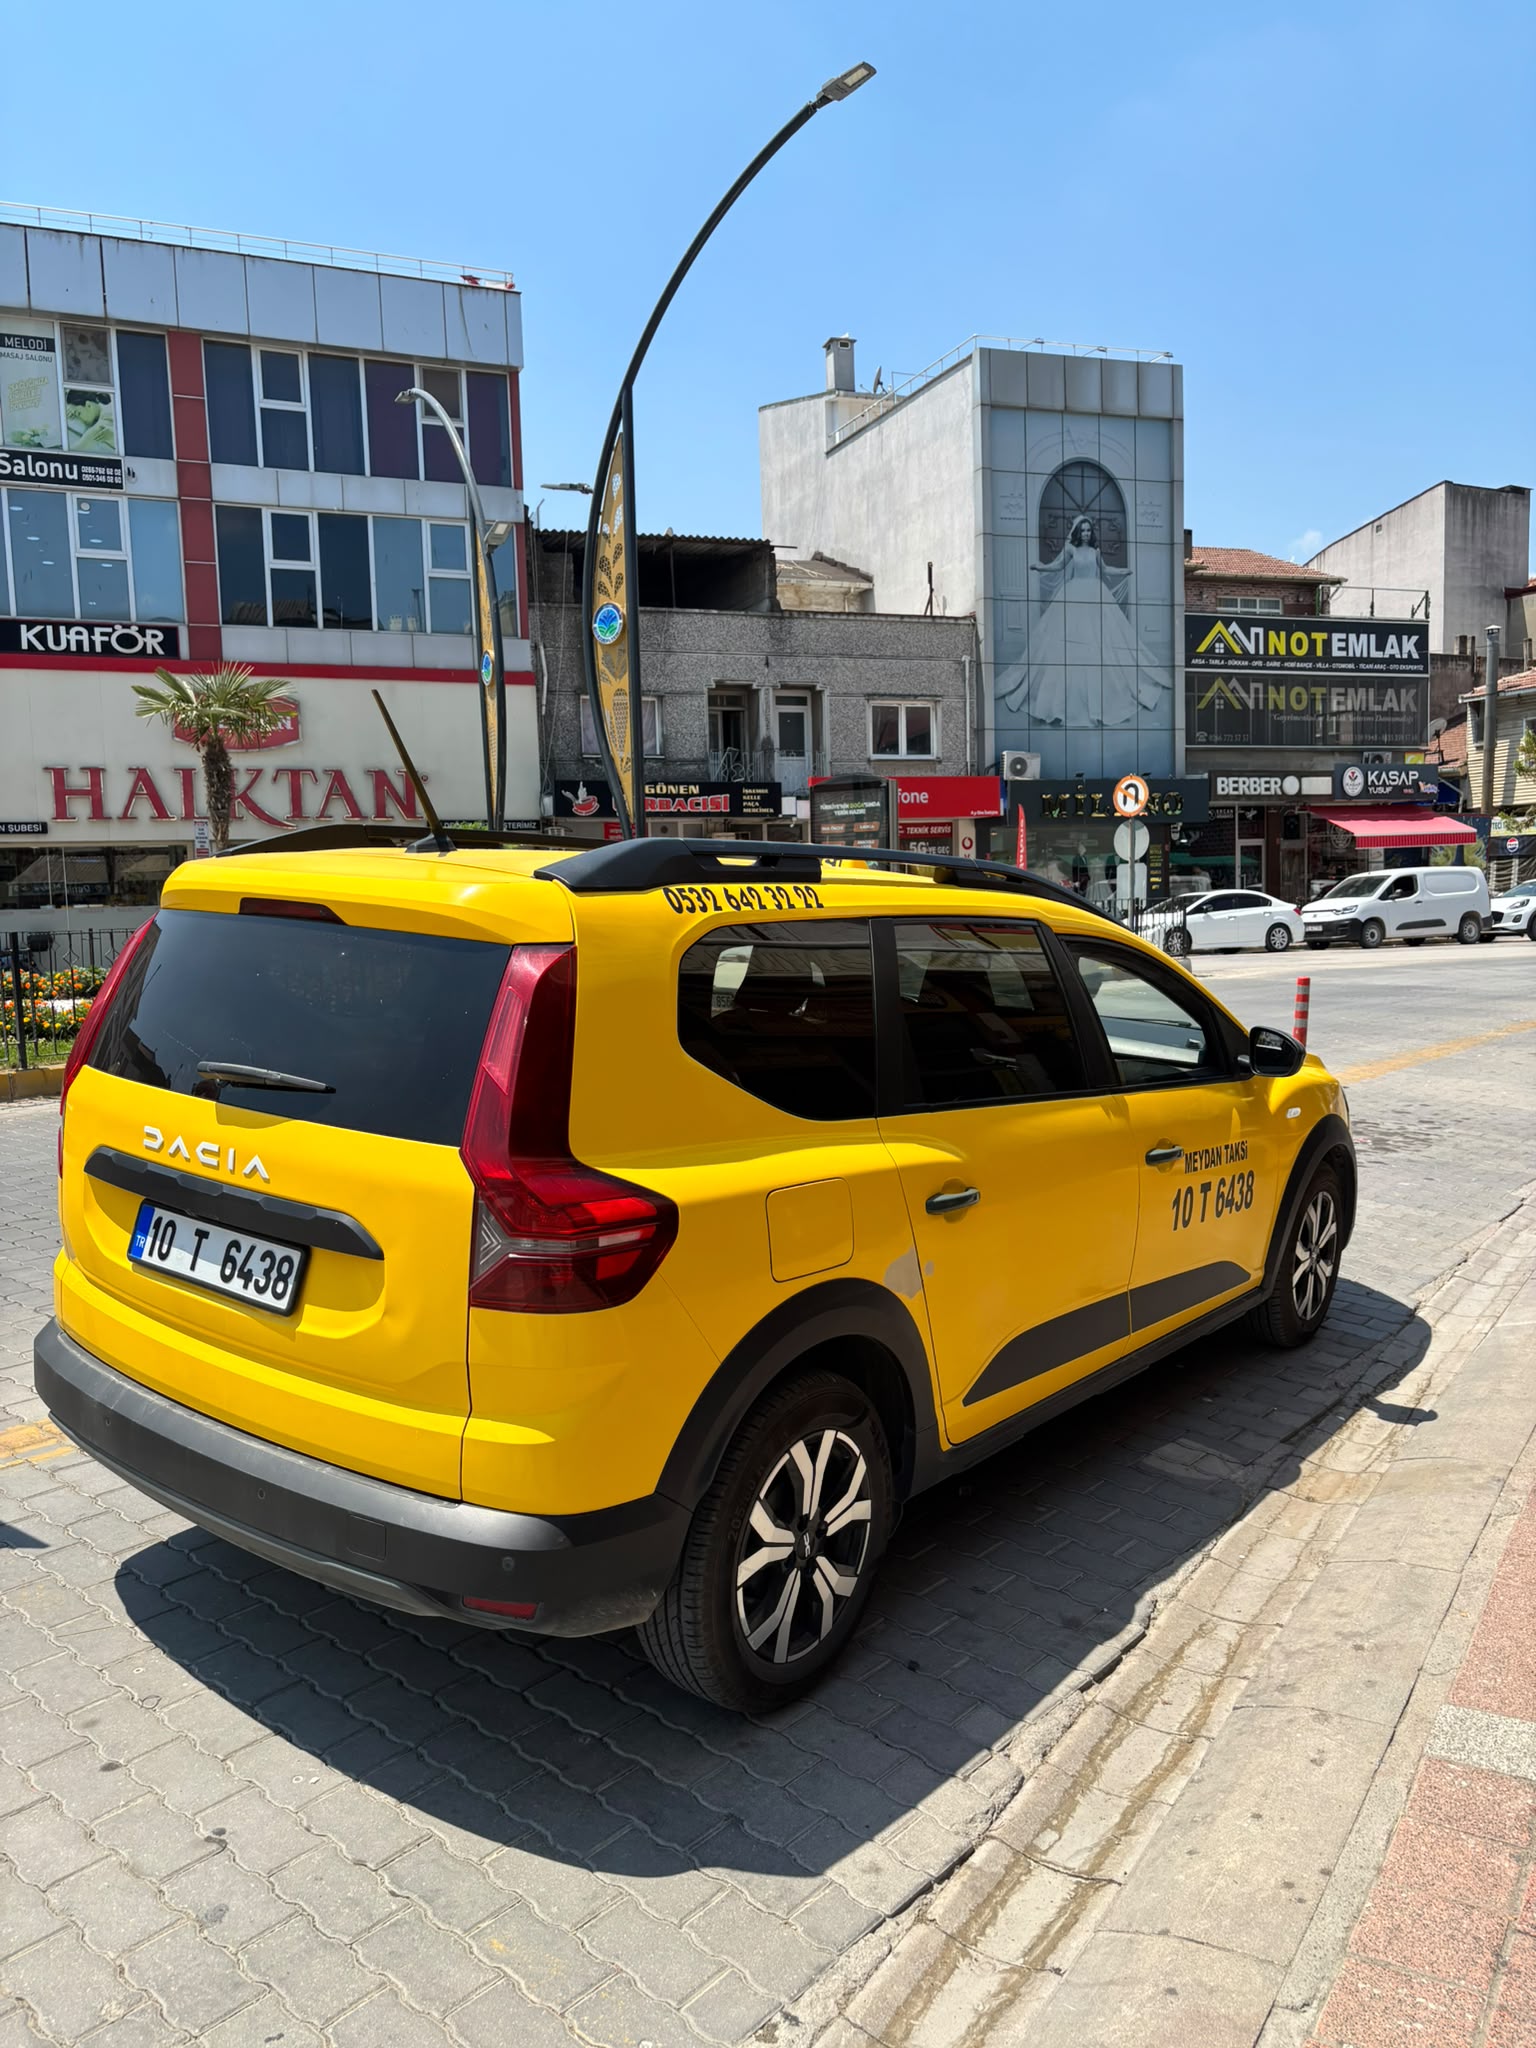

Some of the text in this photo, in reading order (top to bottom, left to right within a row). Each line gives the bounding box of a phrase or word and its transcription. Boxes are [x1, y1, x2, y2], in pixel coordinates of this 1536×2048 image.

[4, 337, 47, 351] MELODİ
[0, 453, 78, 480] Salonu
[20, 624, 165, 655] KUAFÖR
[1331, 632, 1420, 660] EMLAK
[1330, 687, 1417, 712] EMLAK
[644, 782, 700, 795] GÖNEN
[1217, 777, 1282, 796] BERBER
[1368, 771, 1419, 786] KASAP
[43, 767, 427, 829] HALKTAN
[1042, 785, 1184, 818] MİLNO
[7, 823, 42, 833] ŞUBESİ
[662, 886, 824, 914] 0532 642 32 22
[143, 1125, 271, 1183] DACIA
[1184, 1146, 1222, 1174] MEYDAN
[1171, 1170, 1255, 1231] 10 T 6438
[136, 1234, 146, 1248] TR
[148, 1216, 295, 1301] 10 T 6438
